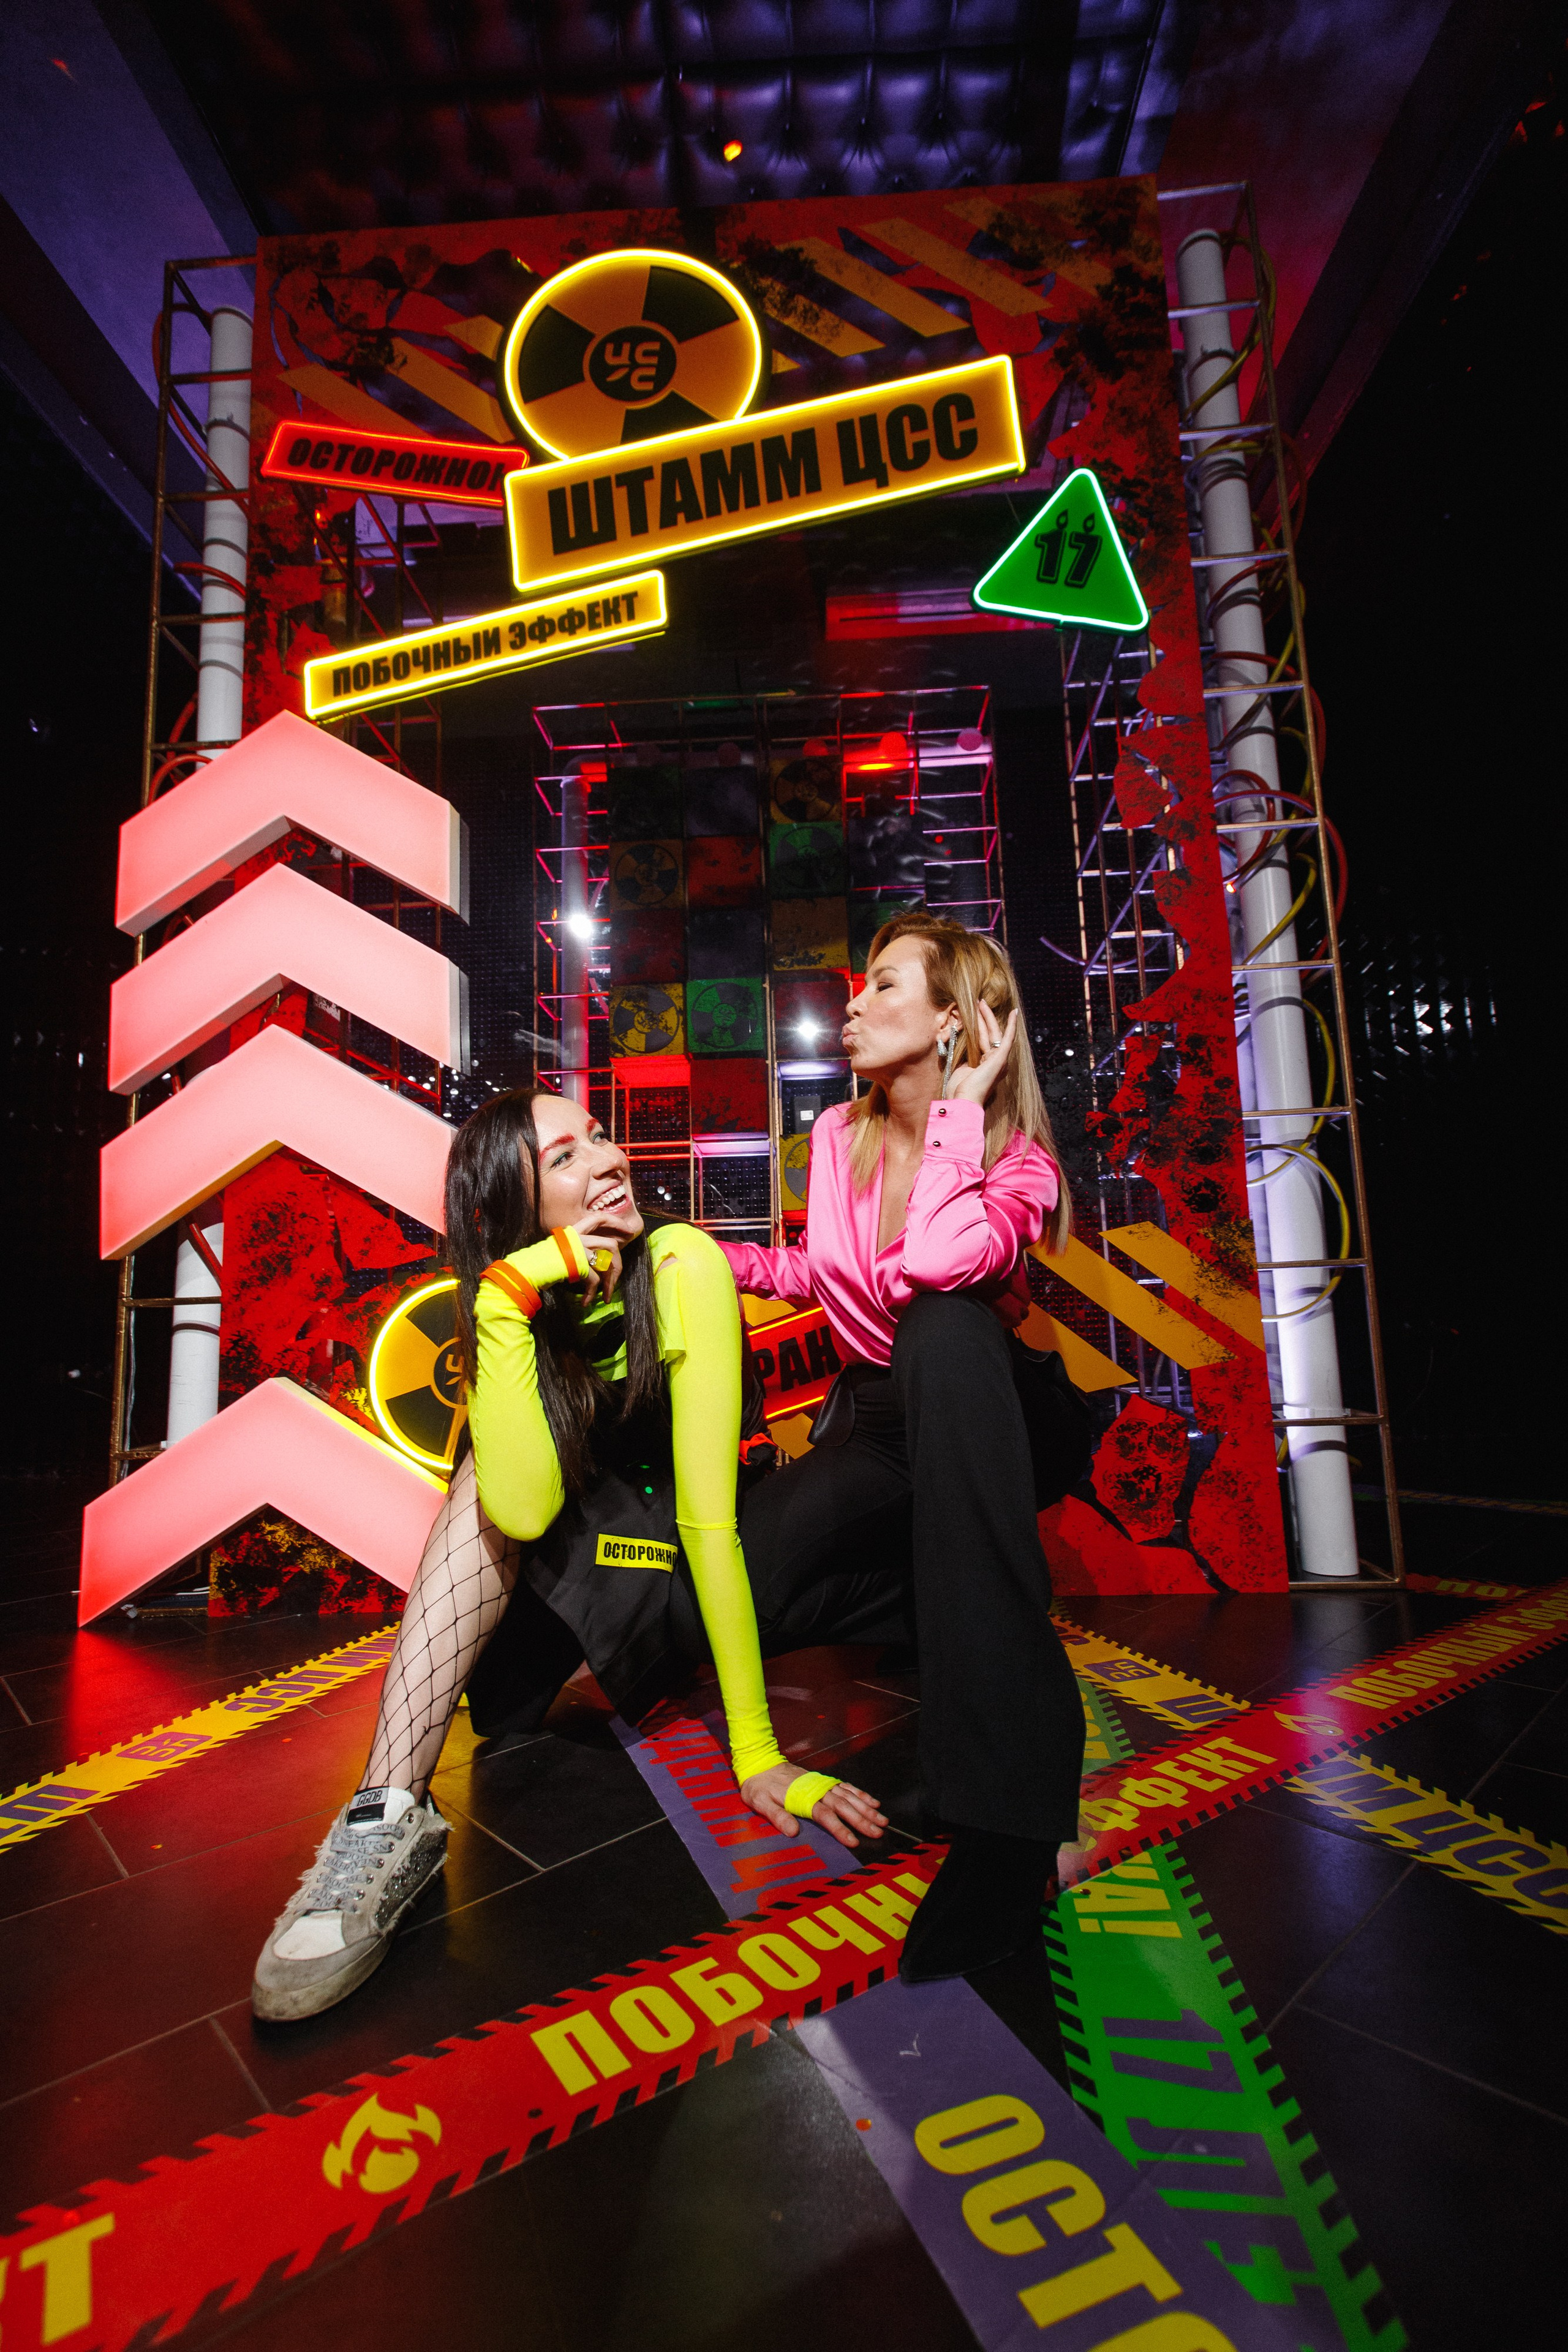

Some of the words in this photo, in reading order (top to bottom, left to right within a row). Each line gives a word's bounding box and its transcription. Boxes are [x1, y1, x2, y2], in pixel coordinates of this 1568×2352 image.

[548, 427, 823, 556] ШТАММ
[835, 393, 979, 489] ЦСС
[1034, 526, 1103, 589] 17
[508, 591, 639, 650] ЭФФЕКТ
[356, 1790, 383, 1807] GGDB
[1102, 2008, 1245, 2094] 17
[914, 2093, 1238, 2352] ОСТ
